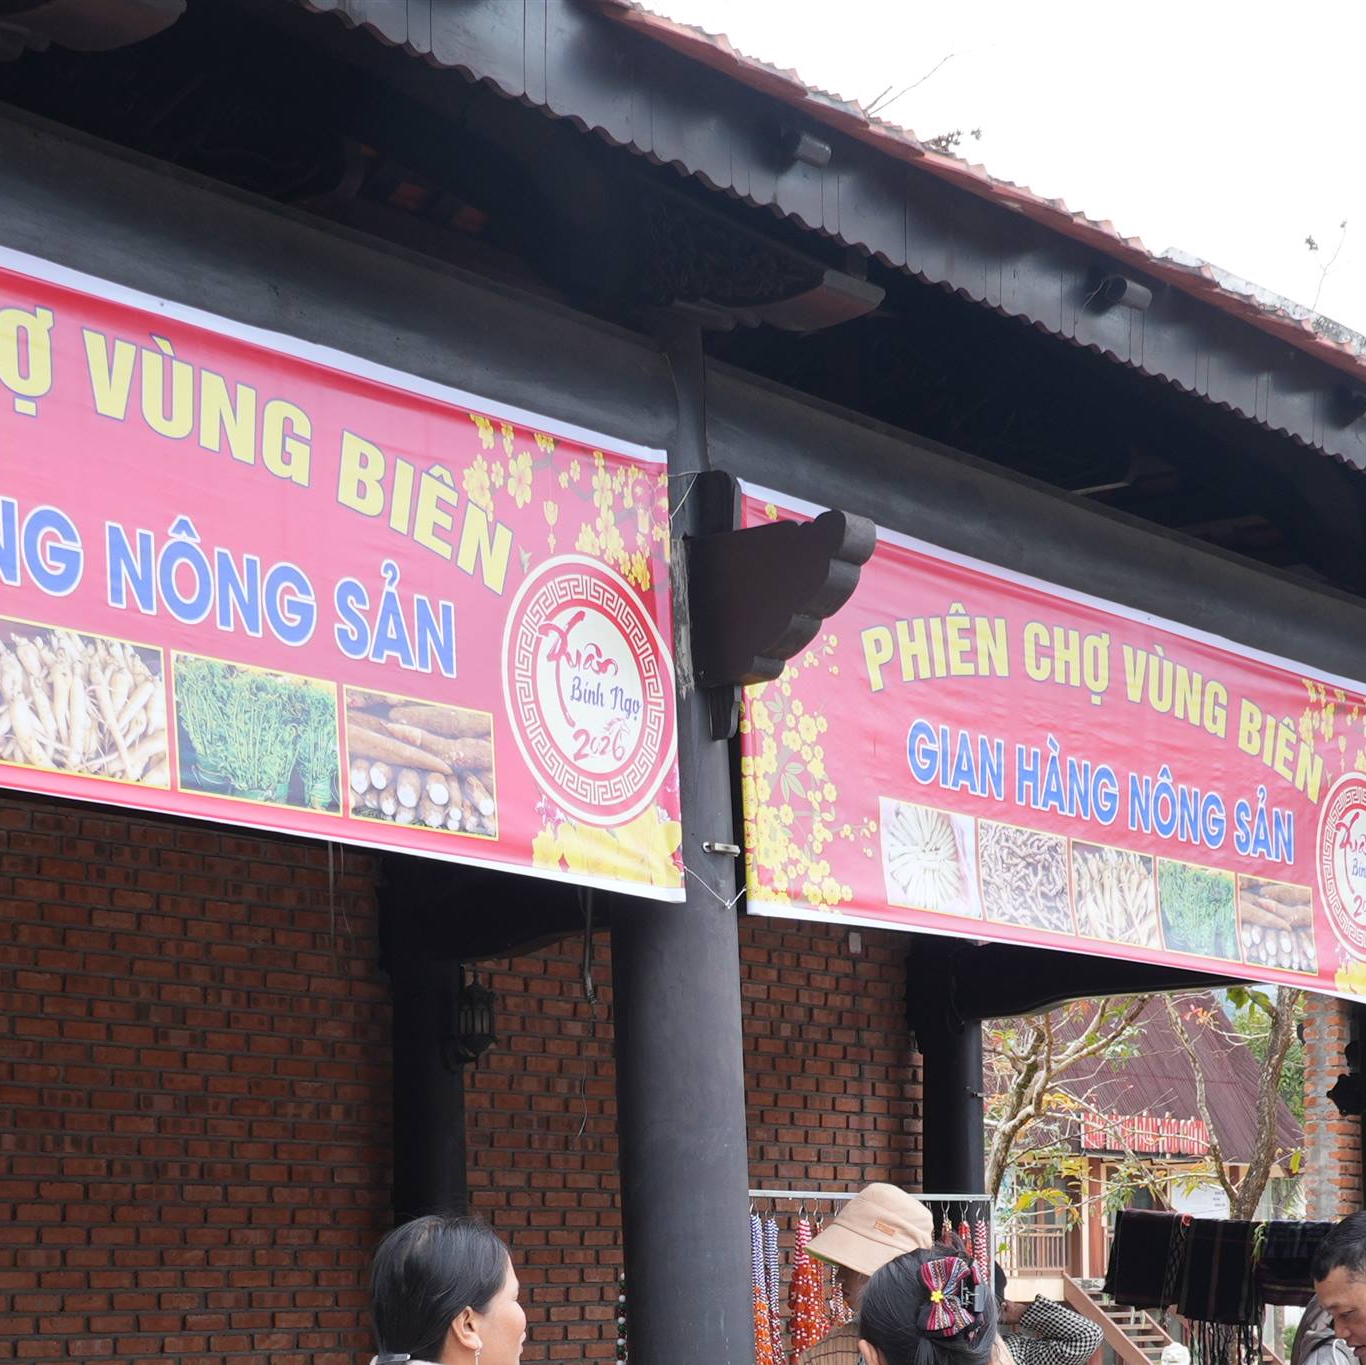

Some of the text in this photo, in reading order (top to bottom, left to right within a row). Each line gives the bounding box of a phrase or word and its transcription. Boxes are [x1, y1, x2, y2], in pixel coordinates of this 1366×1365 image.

[82, 334, 313, 488] VÙNG
[337, 429, 514, 596] BIÊN
[105, 514, 317, 647] NÔNG
[334, 559, 457, 678] SẢN
[538, 610, 619, 728] Xuân
[570, 675, 641, 720] Bính Ngọ
[573, 728, 625, 762] 2026
[860, 602, 1324, 805] PHIÊN CHỢ VÙNG BIÊN
[907, 718, 1294, 865] GIAN HÀNG NÔNG SẢN
